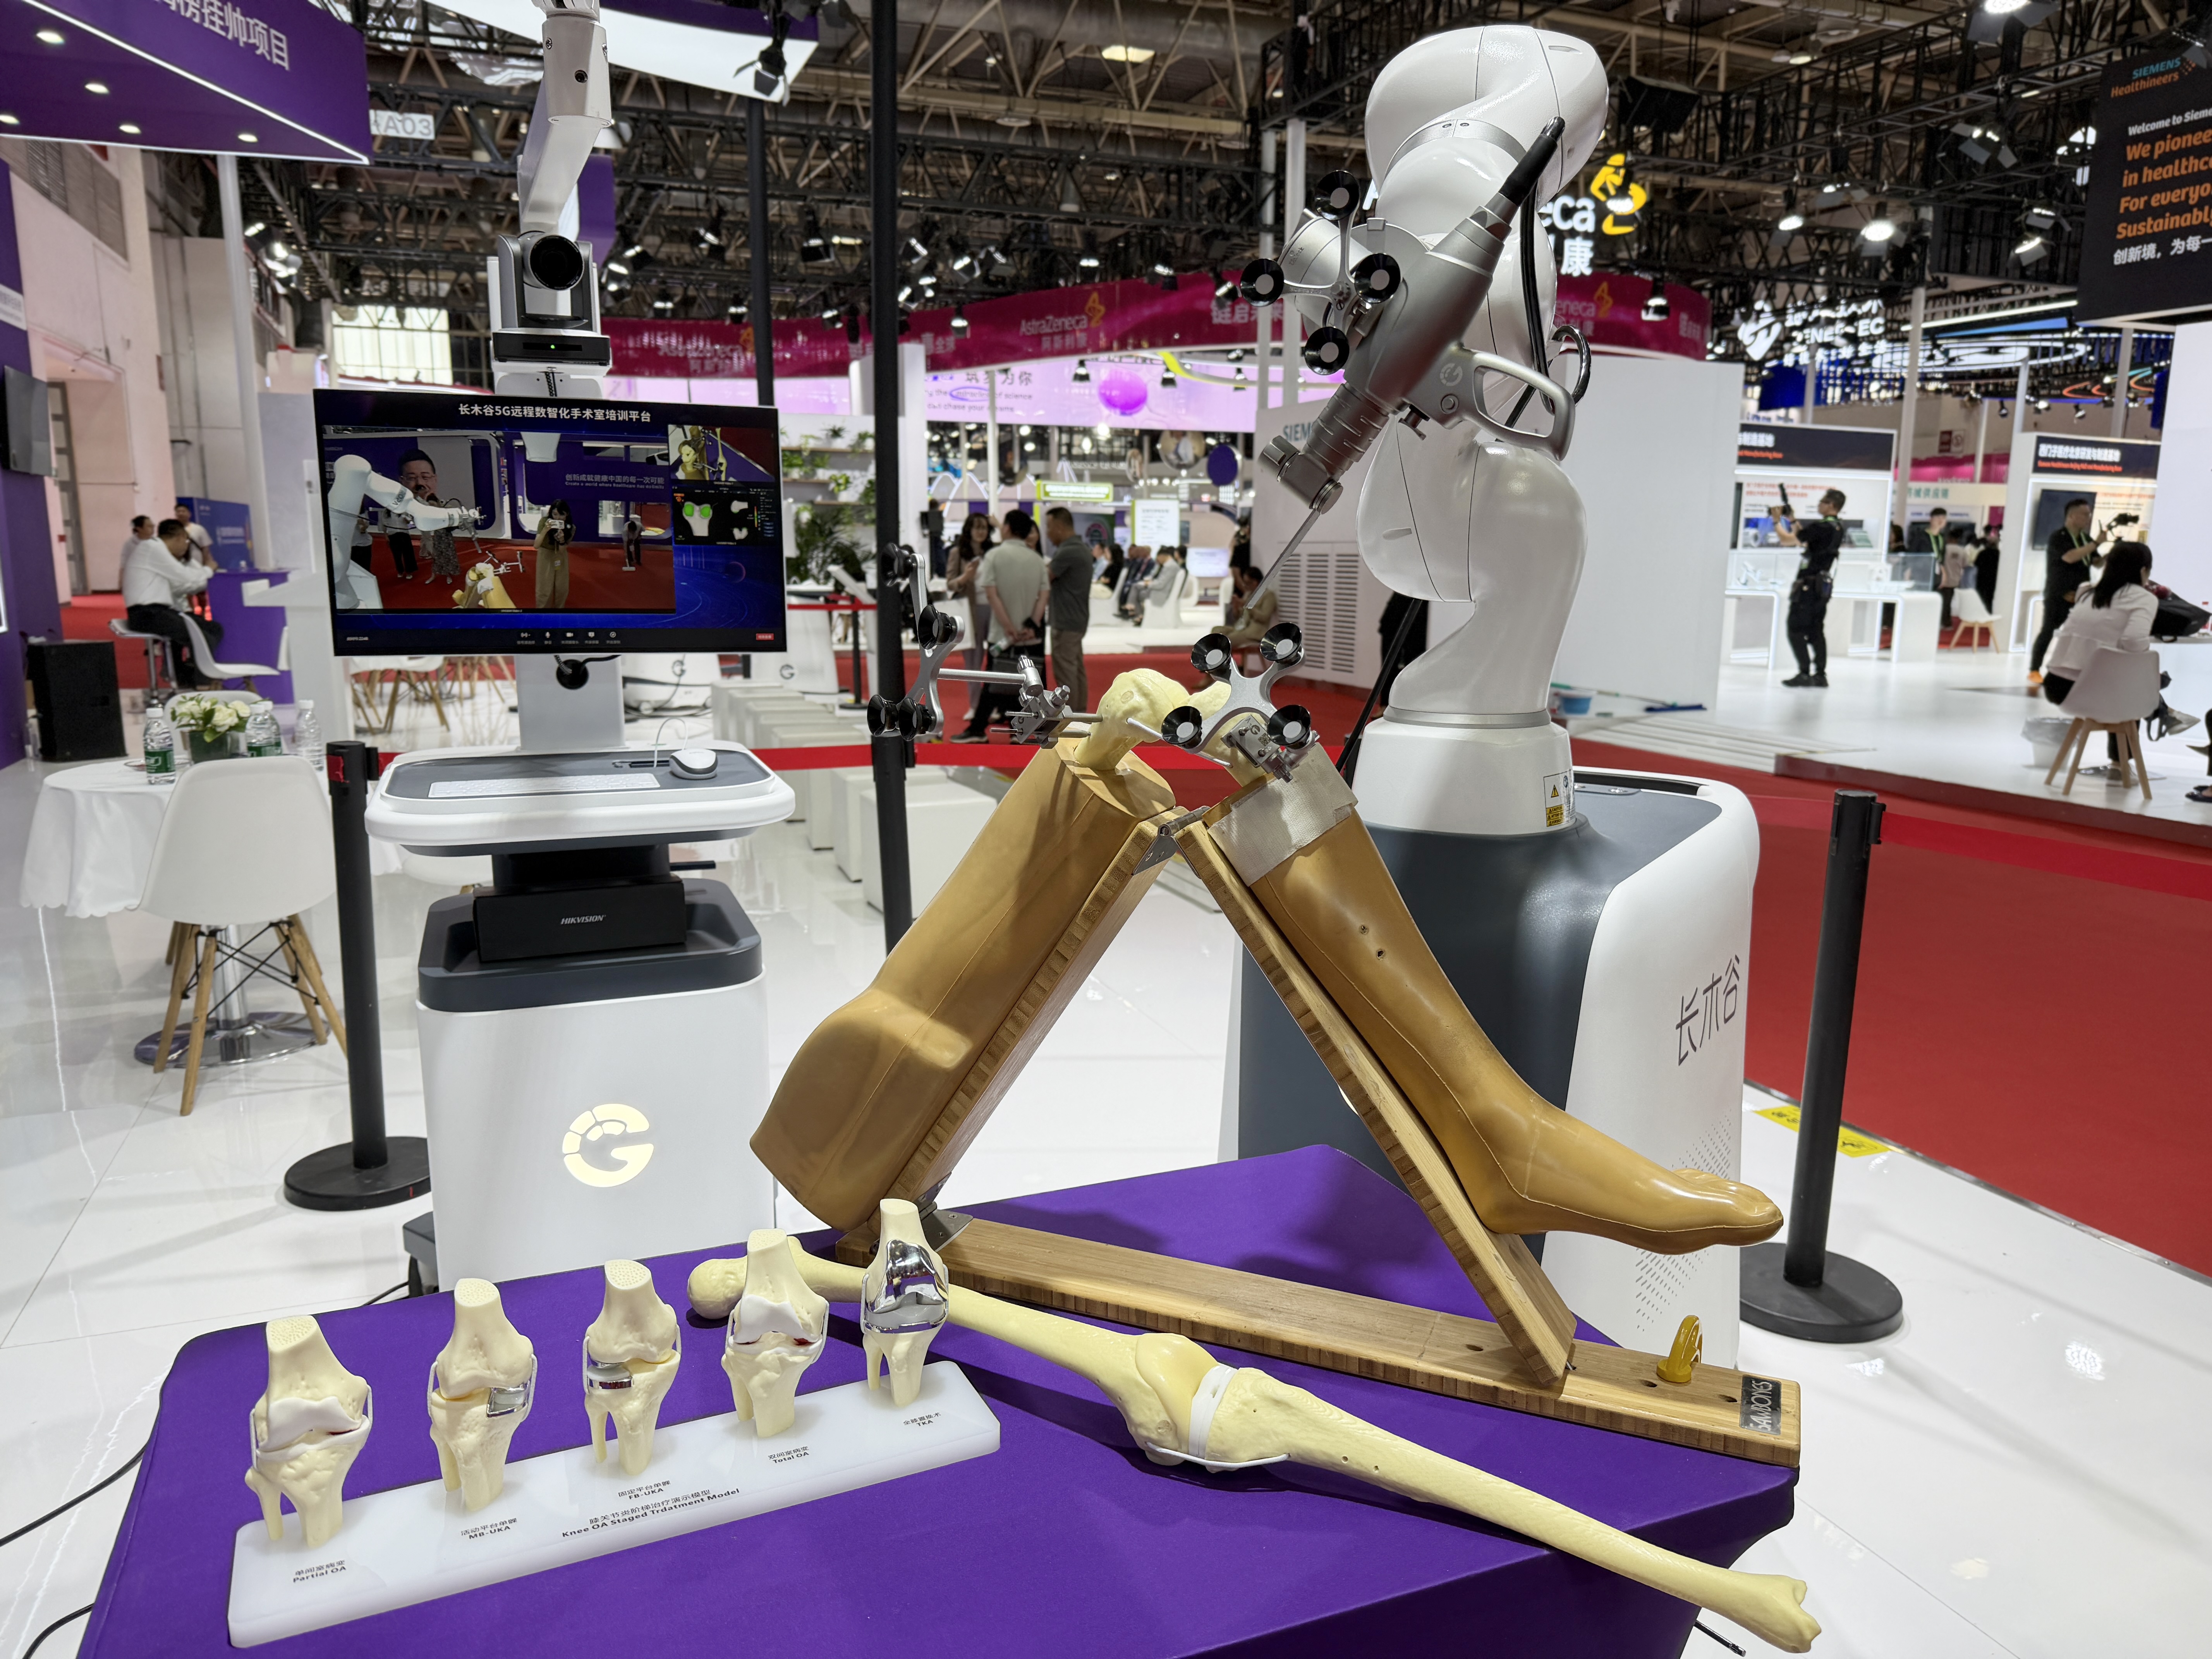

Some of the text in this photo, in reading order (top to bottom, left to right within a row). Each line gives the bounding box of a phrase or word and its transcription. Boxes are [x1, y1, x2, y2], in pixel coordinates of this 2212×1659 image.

[163, 0, 289, 71] 榜挂帅项目
[2133, 57, 2181, 79] SIEMENS
[2111, 72, 2180, 98] Healthineers
[2128, 117, 2171, 136] Welcome
[2172, 114, 2183, 125] to
[2126, 142, 2151, 161] We
[2122, 170, 2138, 188] in
[2119, 183, 2212, 213] For everyo
[1020, 314, 1087, 336] AstraZeneca
[459, 404, 651, 422] 长木谷5G远程数智化手术室培训平台
[565, 474, 665, 484] 创新成就健康中国的每一次可能
[560, 915, 604, 925] HIKVISION
[1675, 954, 1740, 1066] 长木谷
[903, 1412, 941, 1425] 全膝置换术
[768, 1446, 809, 1460] 双间室病变
[773, 1455, 795, 1464] Total
[629, 1488, 664, 1499] FB-UKA
[562, 1527, 589, 1537] Knee
[611, 1511, 647, 1525] Staged
[707, 1488, 740, 1500] Model
[589, 1489, 711, 1524] 膝关节炎阶梯治疗演示模型
[469, 1526, 511, 1539] MB-UKA
[293, 1570, 328, 1583] Partial
